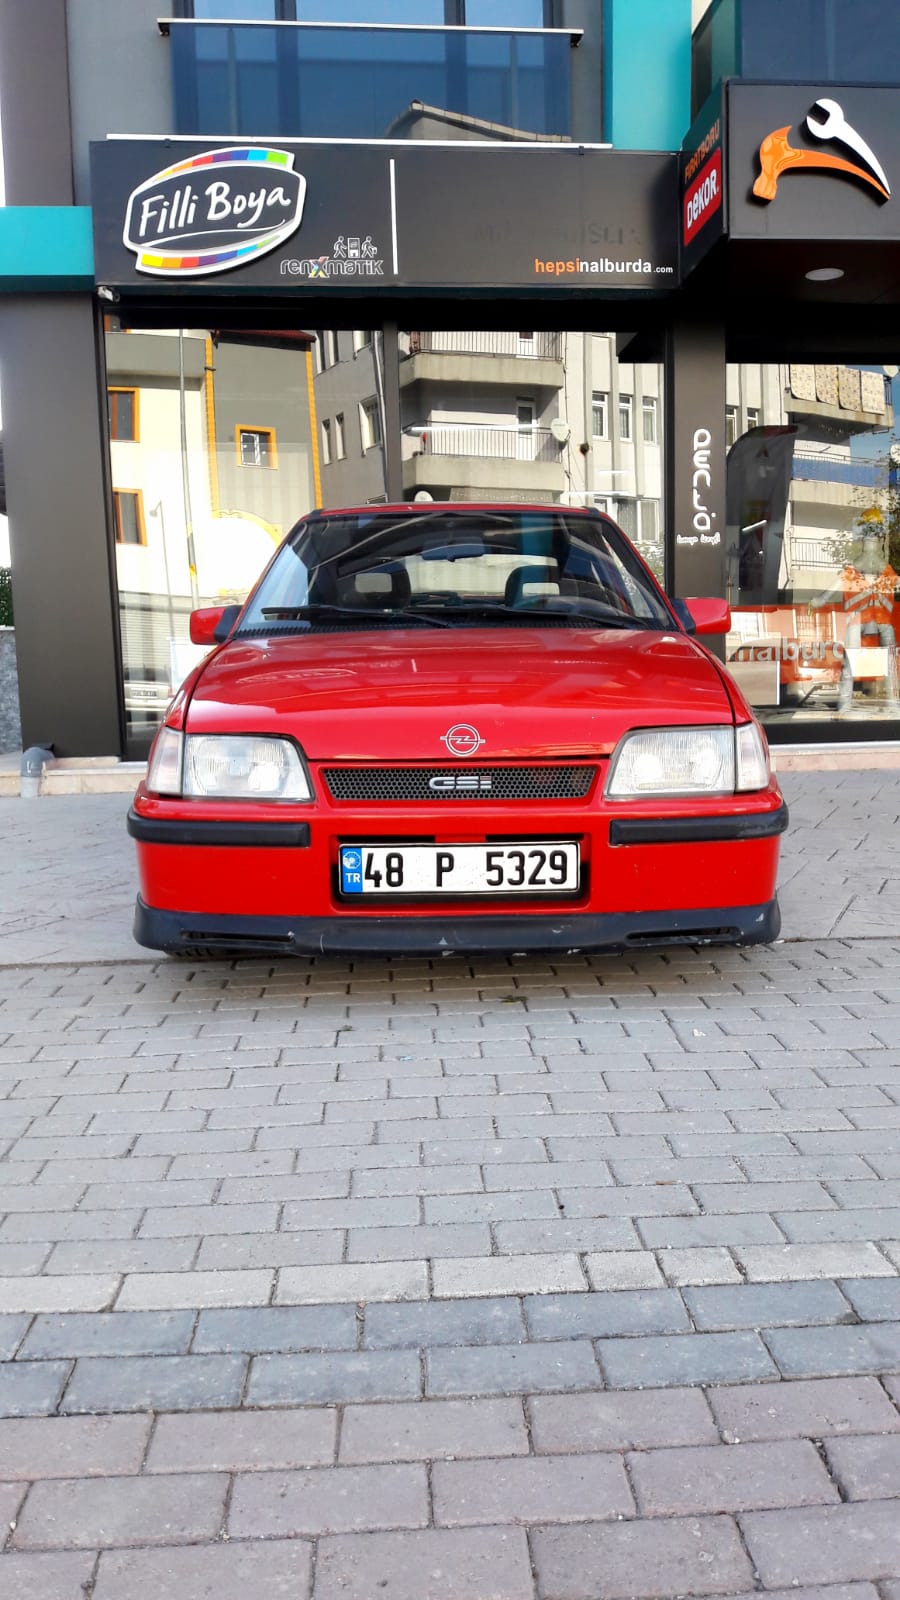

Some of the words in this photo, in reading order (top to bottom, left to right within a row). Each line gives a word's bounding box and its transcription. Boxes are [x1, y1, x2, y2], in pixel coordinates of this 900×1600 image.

[138, 185, 200, 237] Filli
[205, 181, 291, 229] Boya
[345, 872, 361, 884] TR
[364, 851, 404, 888] 48
[435, 852, 454, 887] P
[485, 850, 568, 887] 5329
